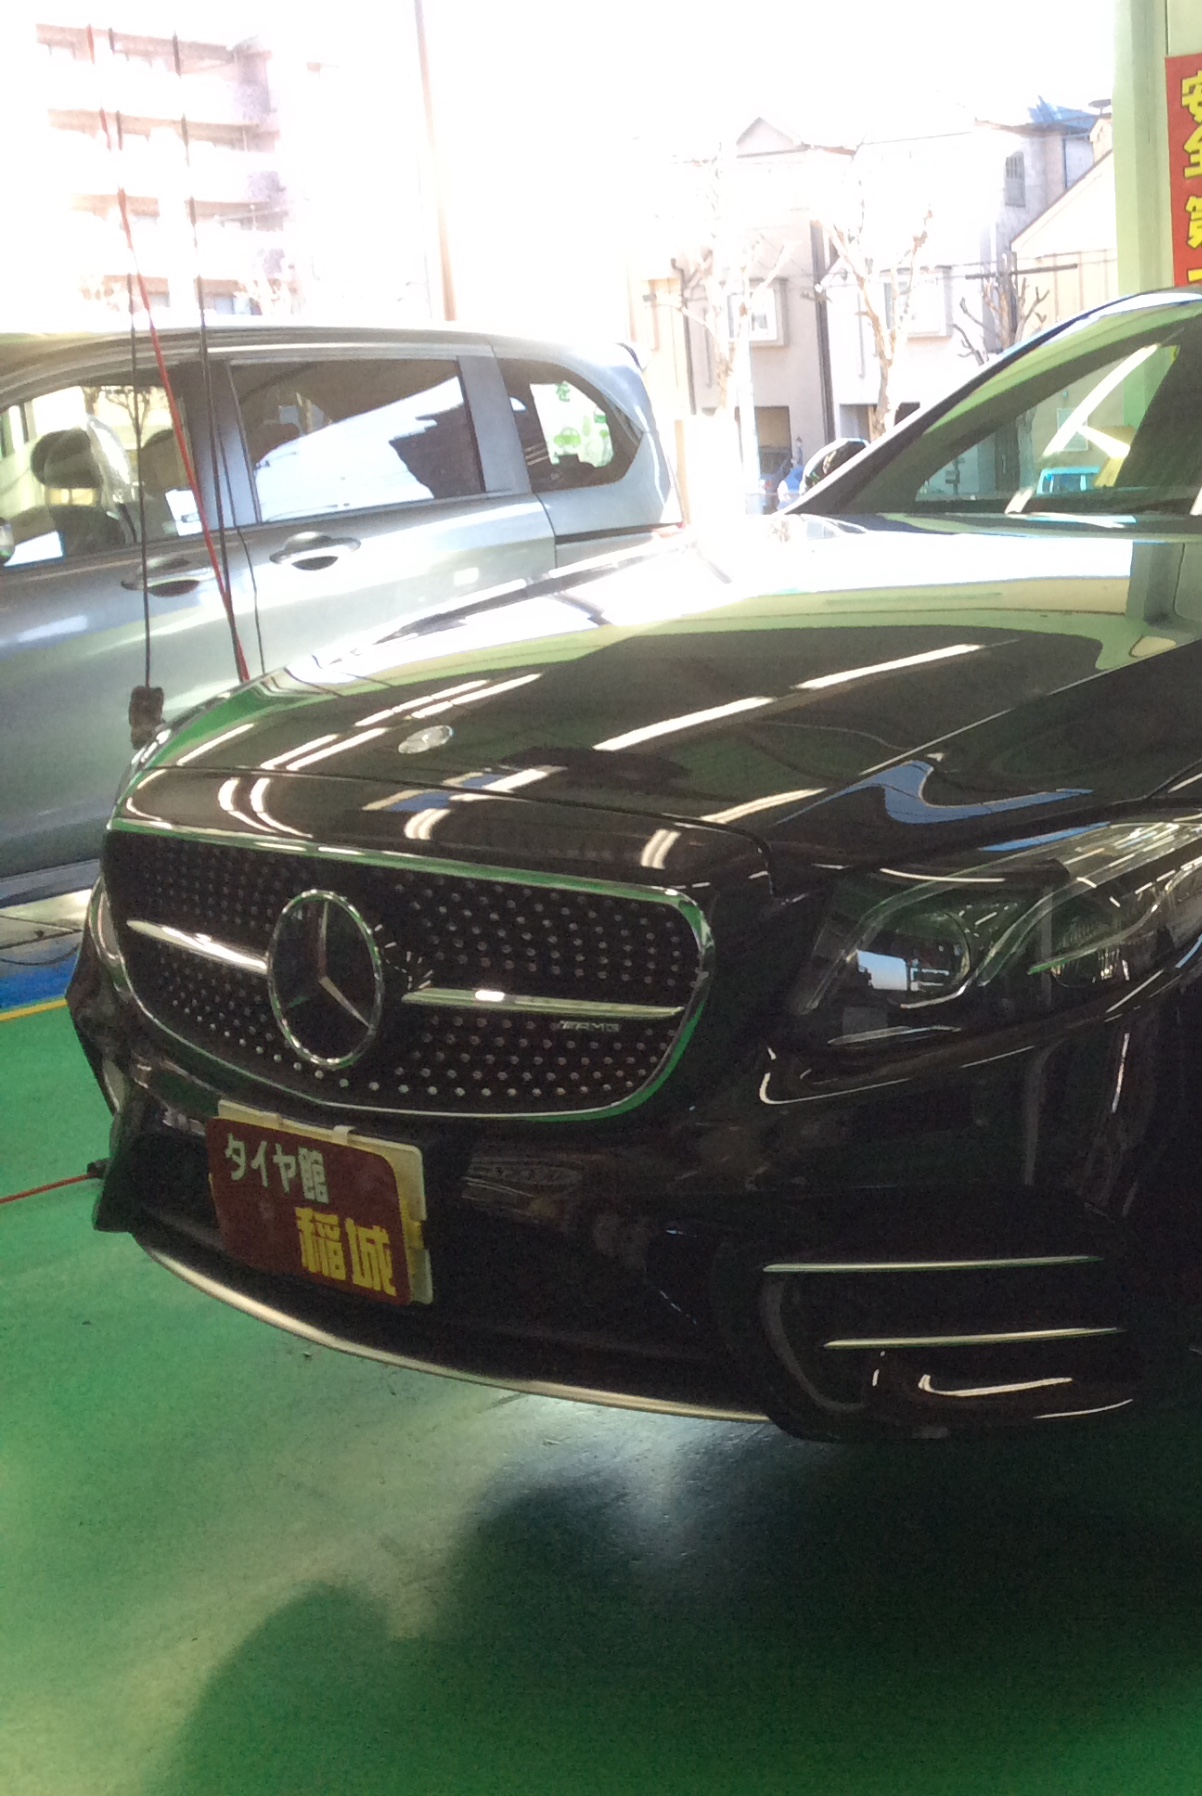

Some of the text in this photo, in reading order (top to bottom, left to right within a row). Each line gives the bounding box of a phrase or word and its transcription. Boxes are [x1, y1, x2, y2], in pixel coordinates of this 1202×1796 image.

[225, 1132, 329, 1204] タイヤ館
[295, 1207, 397, 1296] 稲城
